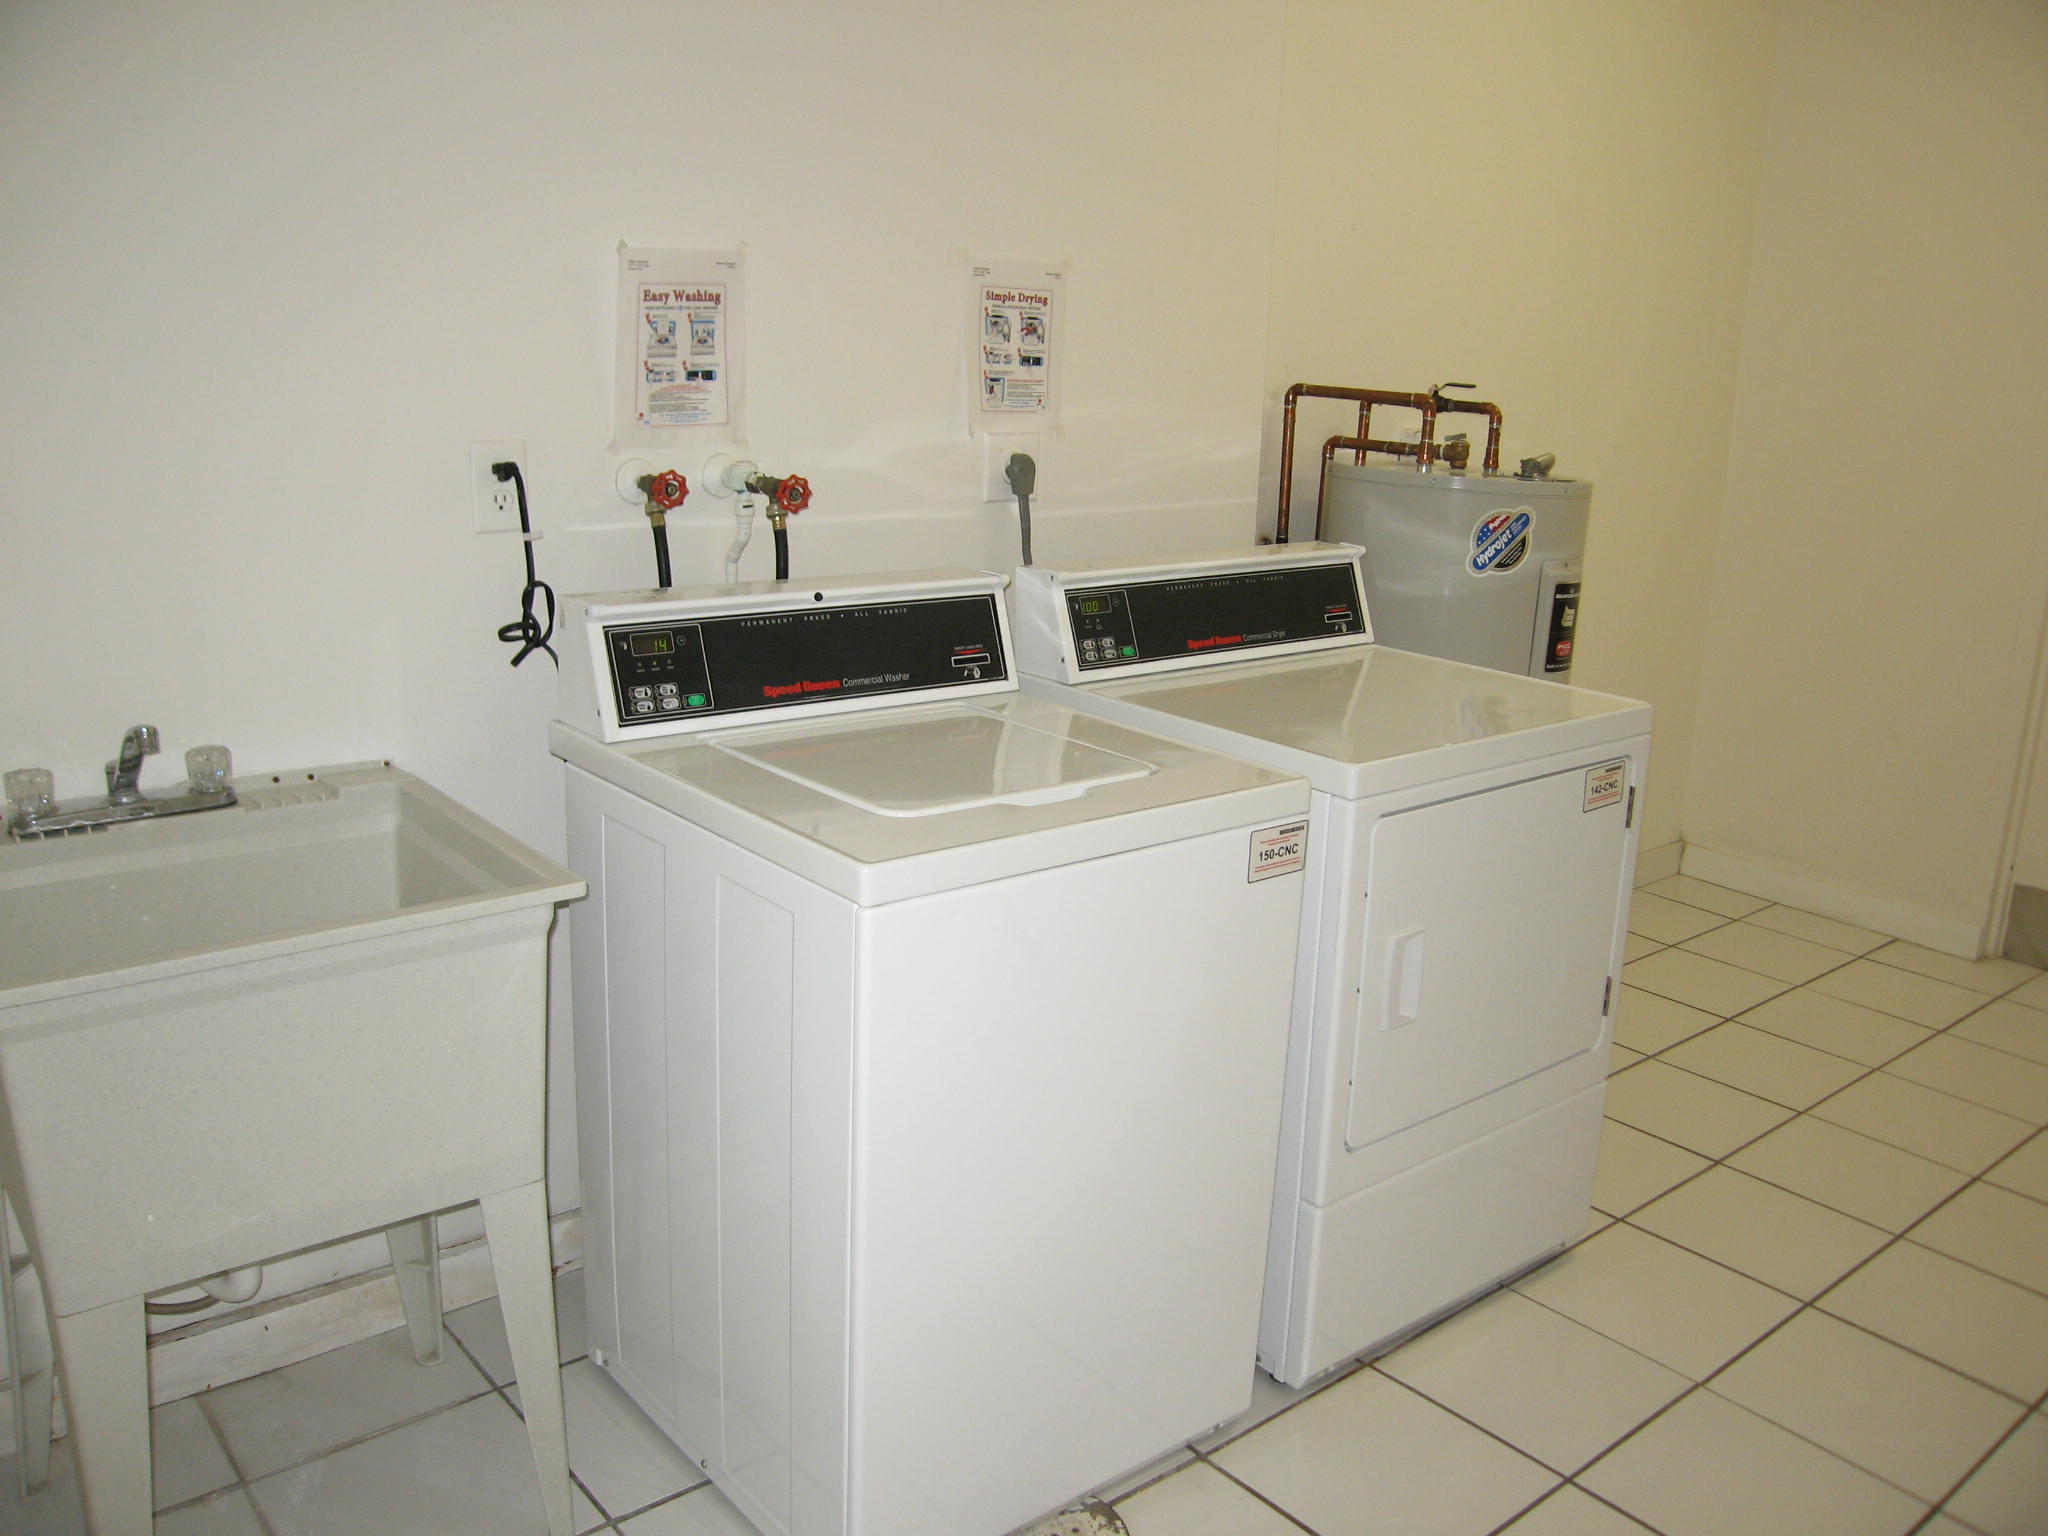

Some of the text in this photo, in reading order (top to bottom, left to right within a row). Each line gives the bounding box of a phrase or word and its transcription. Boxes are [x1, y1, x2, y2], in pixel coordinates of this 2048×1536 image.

[643, 288, 722, 305] Easy Washing
[985, 290, 1049, 307] Simple Drying
[1476, 529, 1512, 567] Hydrojet
[654, 639, 667, 653] 14
[763, 672, 910, 699] Speed Queen Commercial Washer
[1259, 843, 1299, 863] 150-CNC
